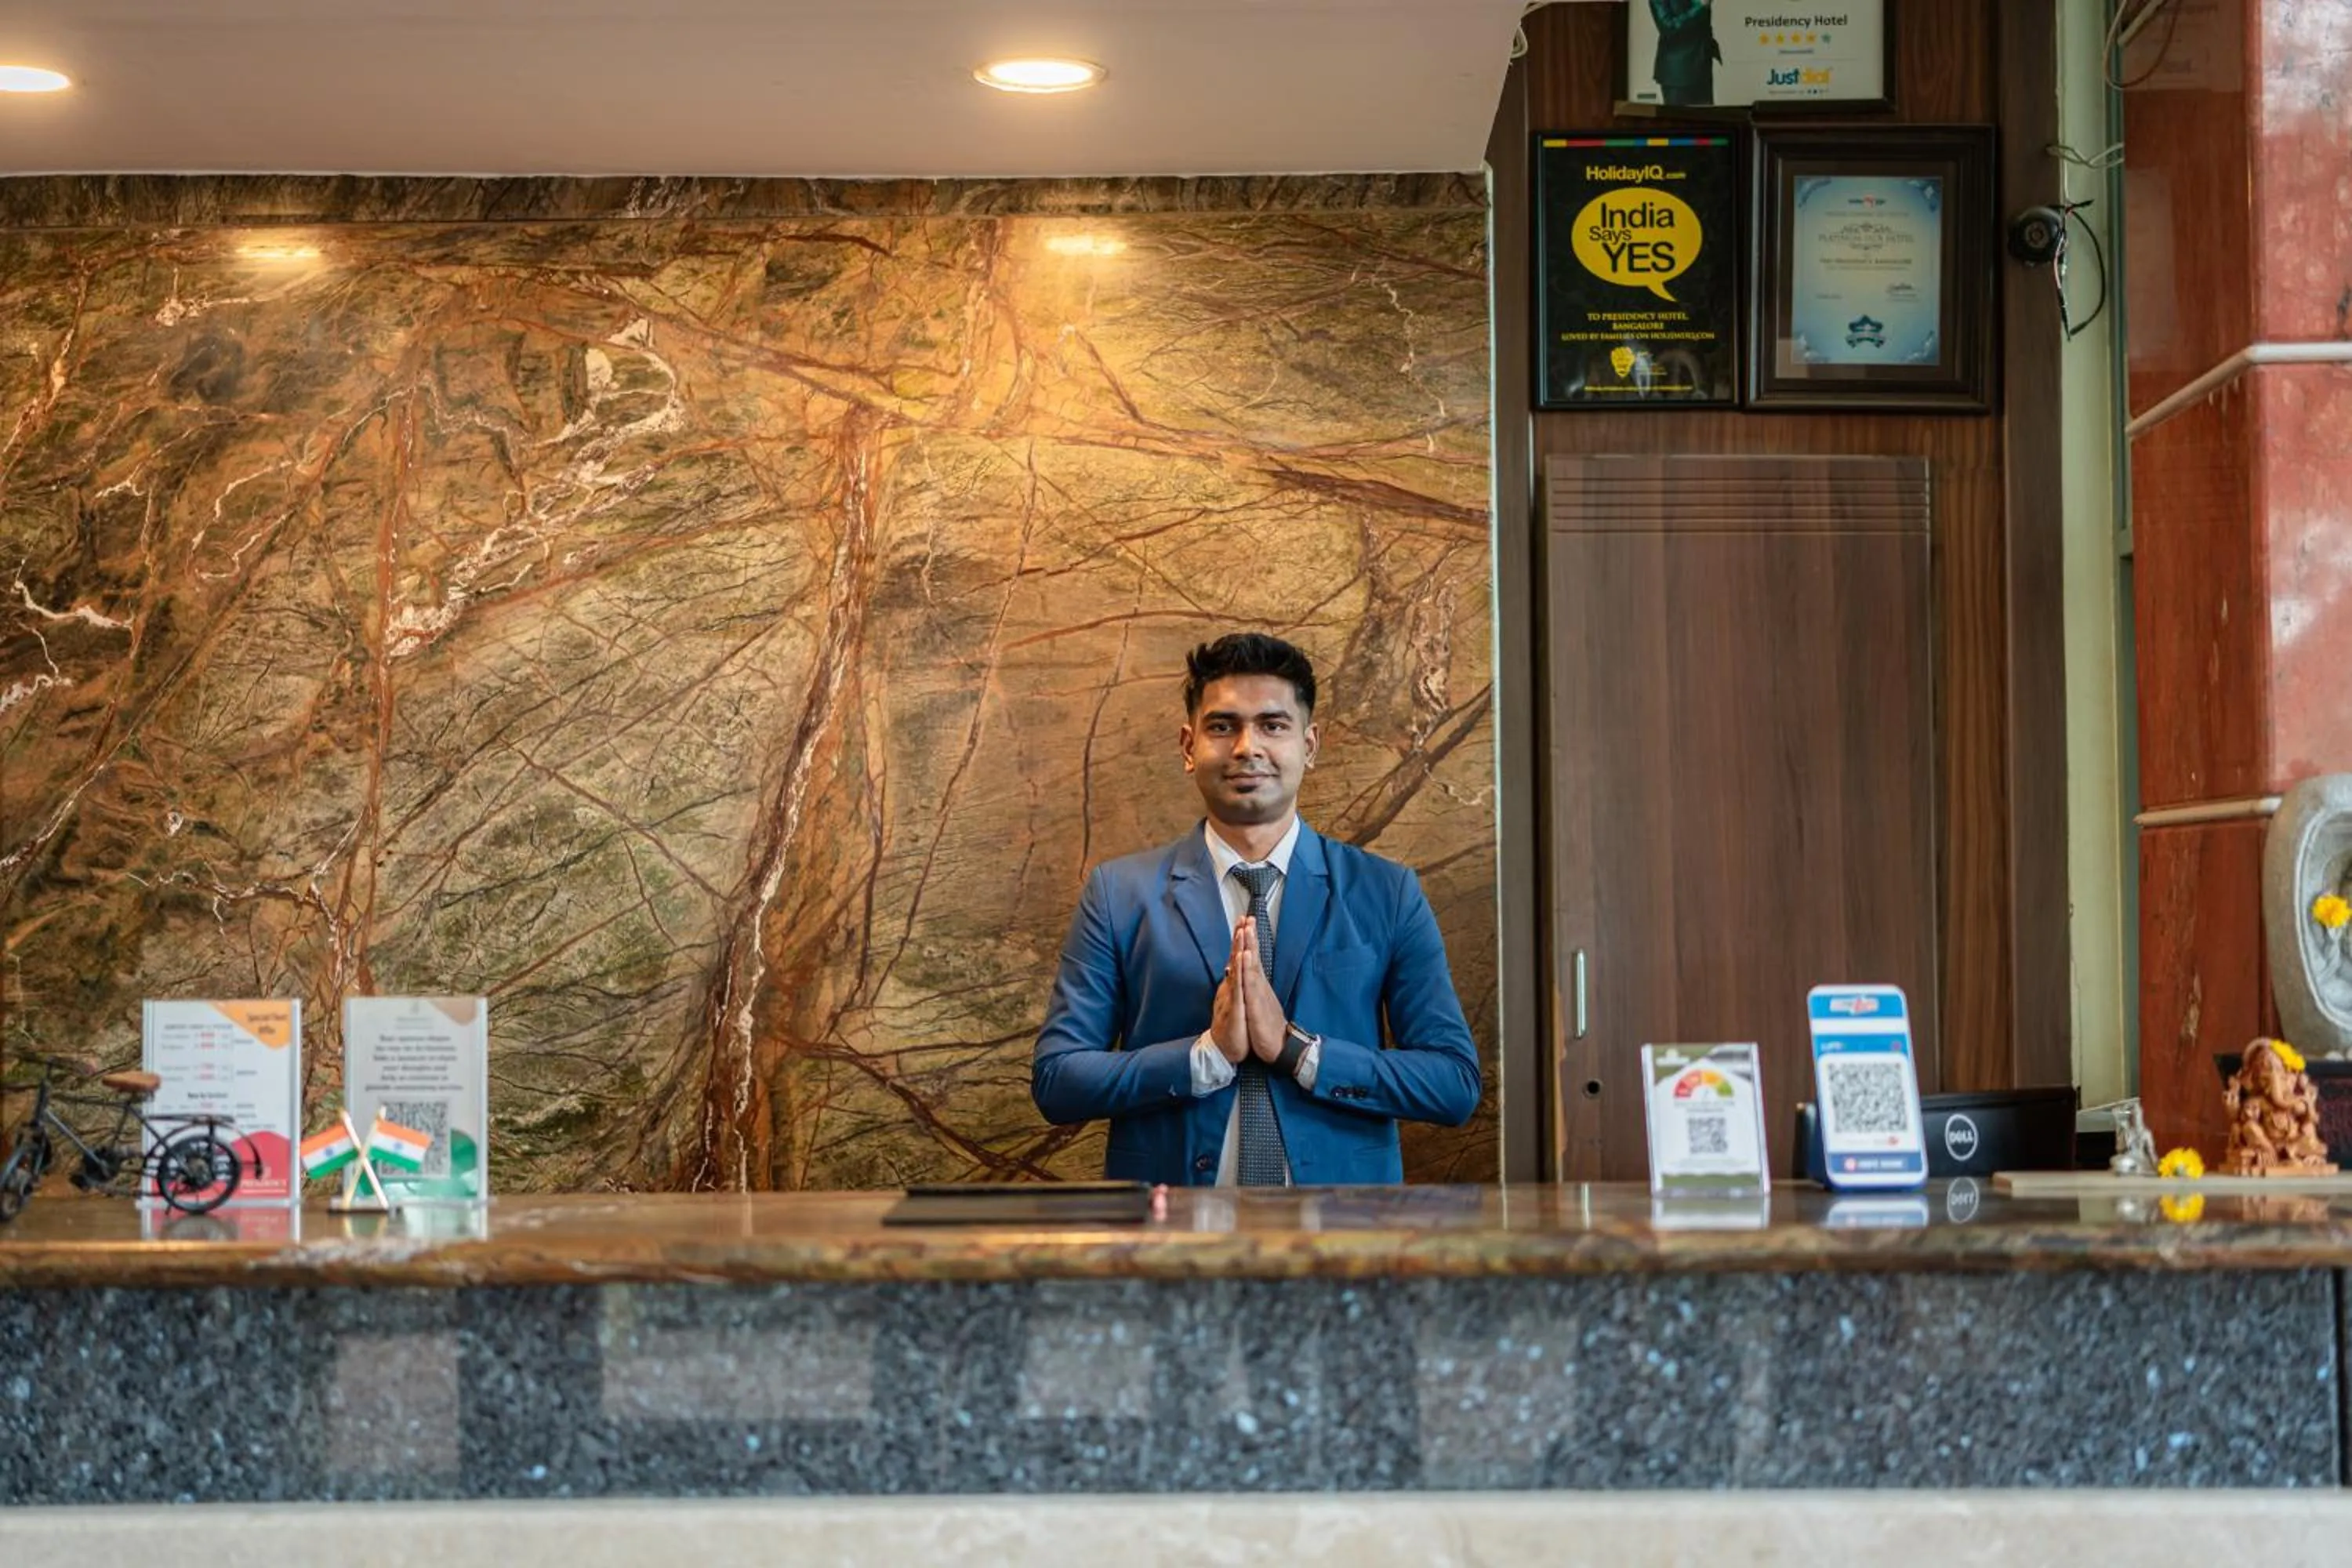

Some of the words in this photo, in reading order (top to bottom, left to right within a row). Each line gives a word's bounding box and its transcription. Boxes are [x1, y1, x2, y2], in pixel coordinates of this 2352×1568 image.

[1744, 16, 1811, 28] Presidency
[1814, 15, 1848, 26] Hotel
[1601, 201, 1675, 229] India
[1589, 226, 1632, 244] Says
[1602, 241, 1675, 273] YES
[1602, 312, 1656, 321] PRESIDENCY
[1948, 1131, 1973, 1145] DELL
